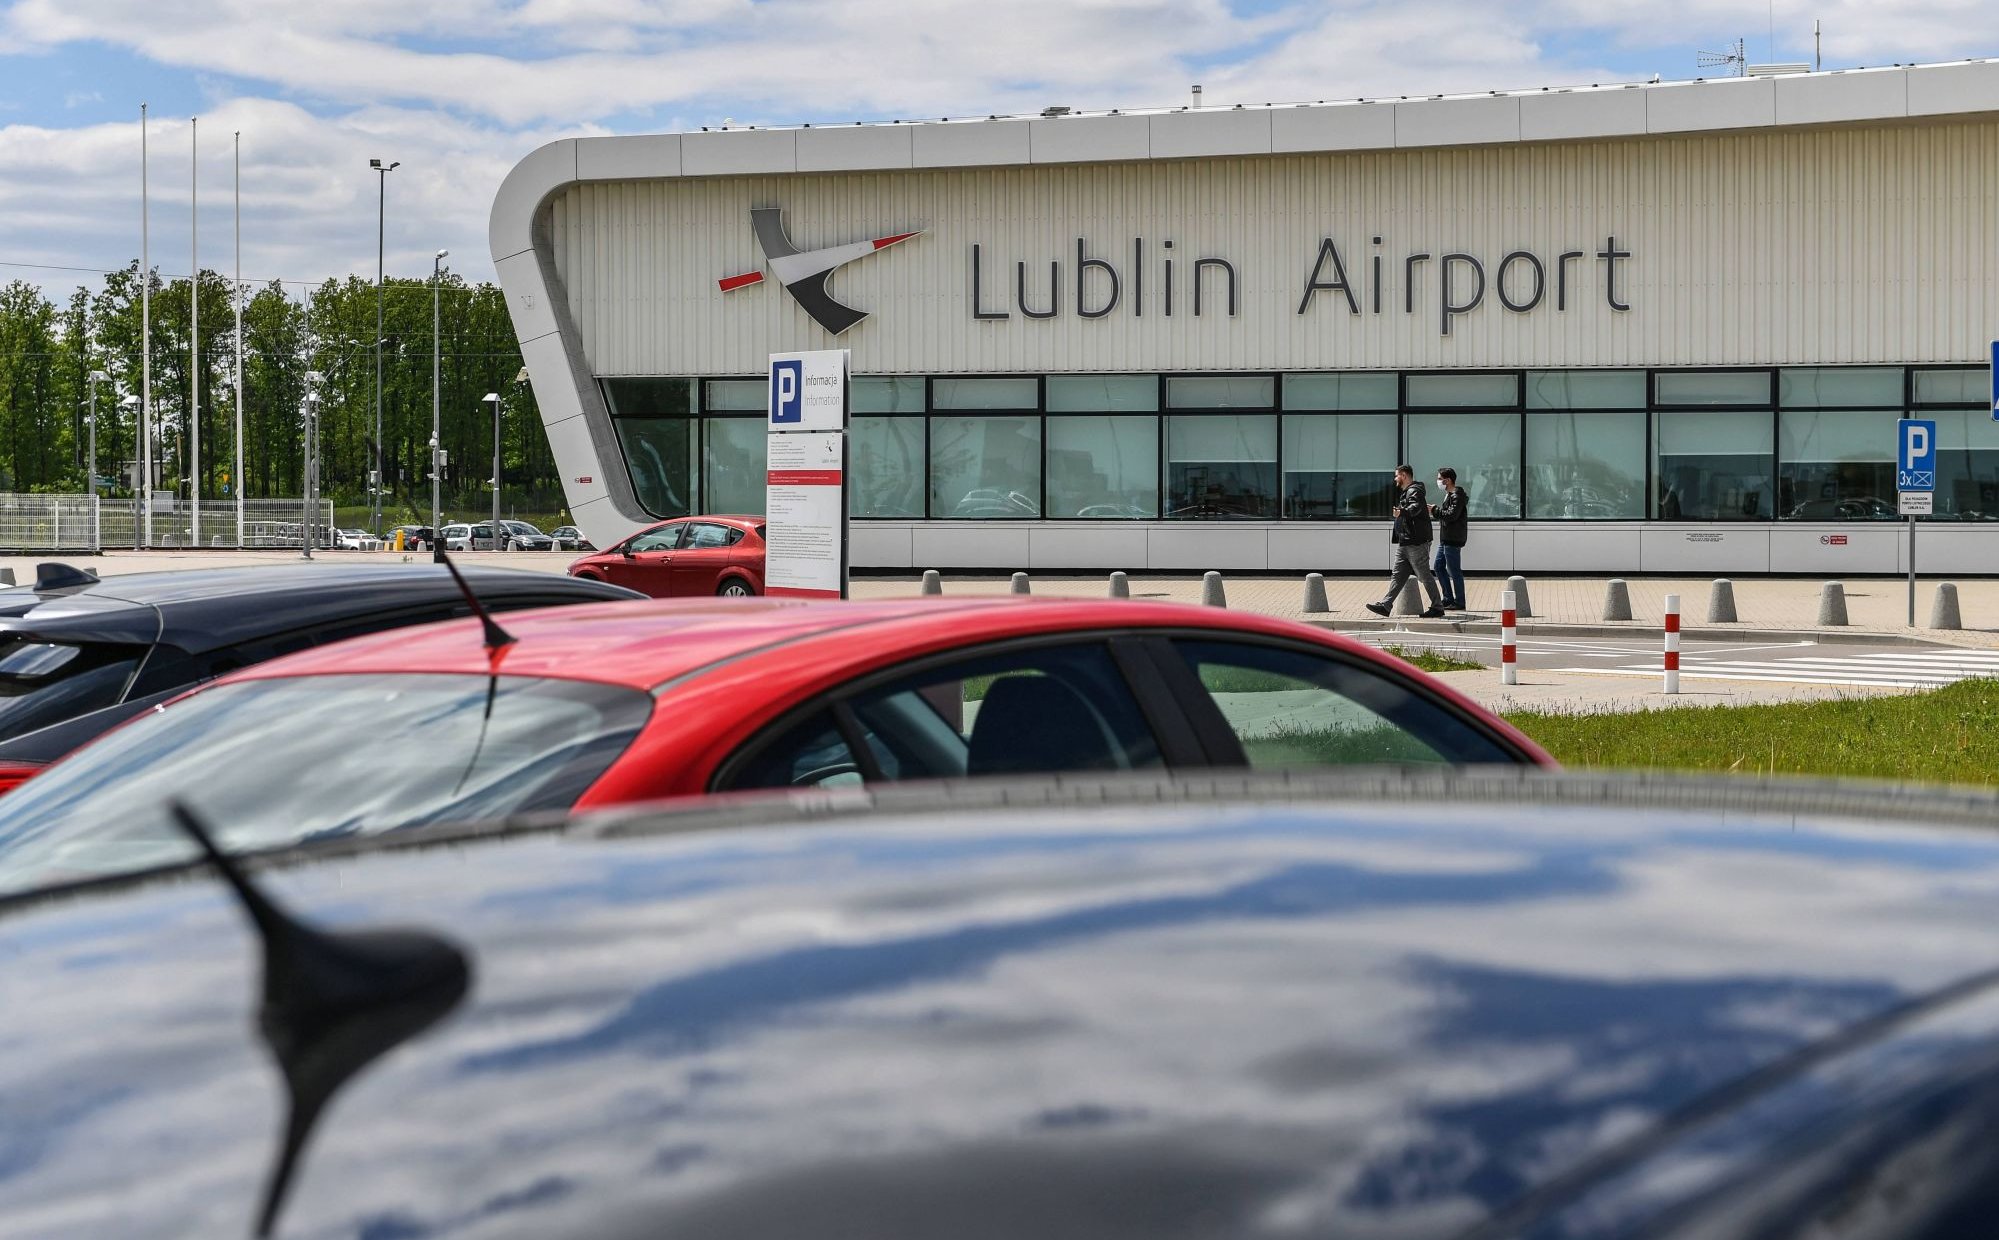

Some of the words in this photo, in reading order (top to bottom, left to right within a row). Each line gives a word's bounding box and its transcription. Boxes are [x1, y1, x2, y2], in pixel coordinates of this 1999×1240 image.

[972, 236, 1237, 320] Lublin
[1297, 235, 1632, 336] Airport
[778, 367, 796, 417] P
[805, 373, 838, 388] Informacja
[805, 395, 840, 407] Information
[1907, 426, 1928, 469] P
[1899, 470, 1912, 487] 3x
